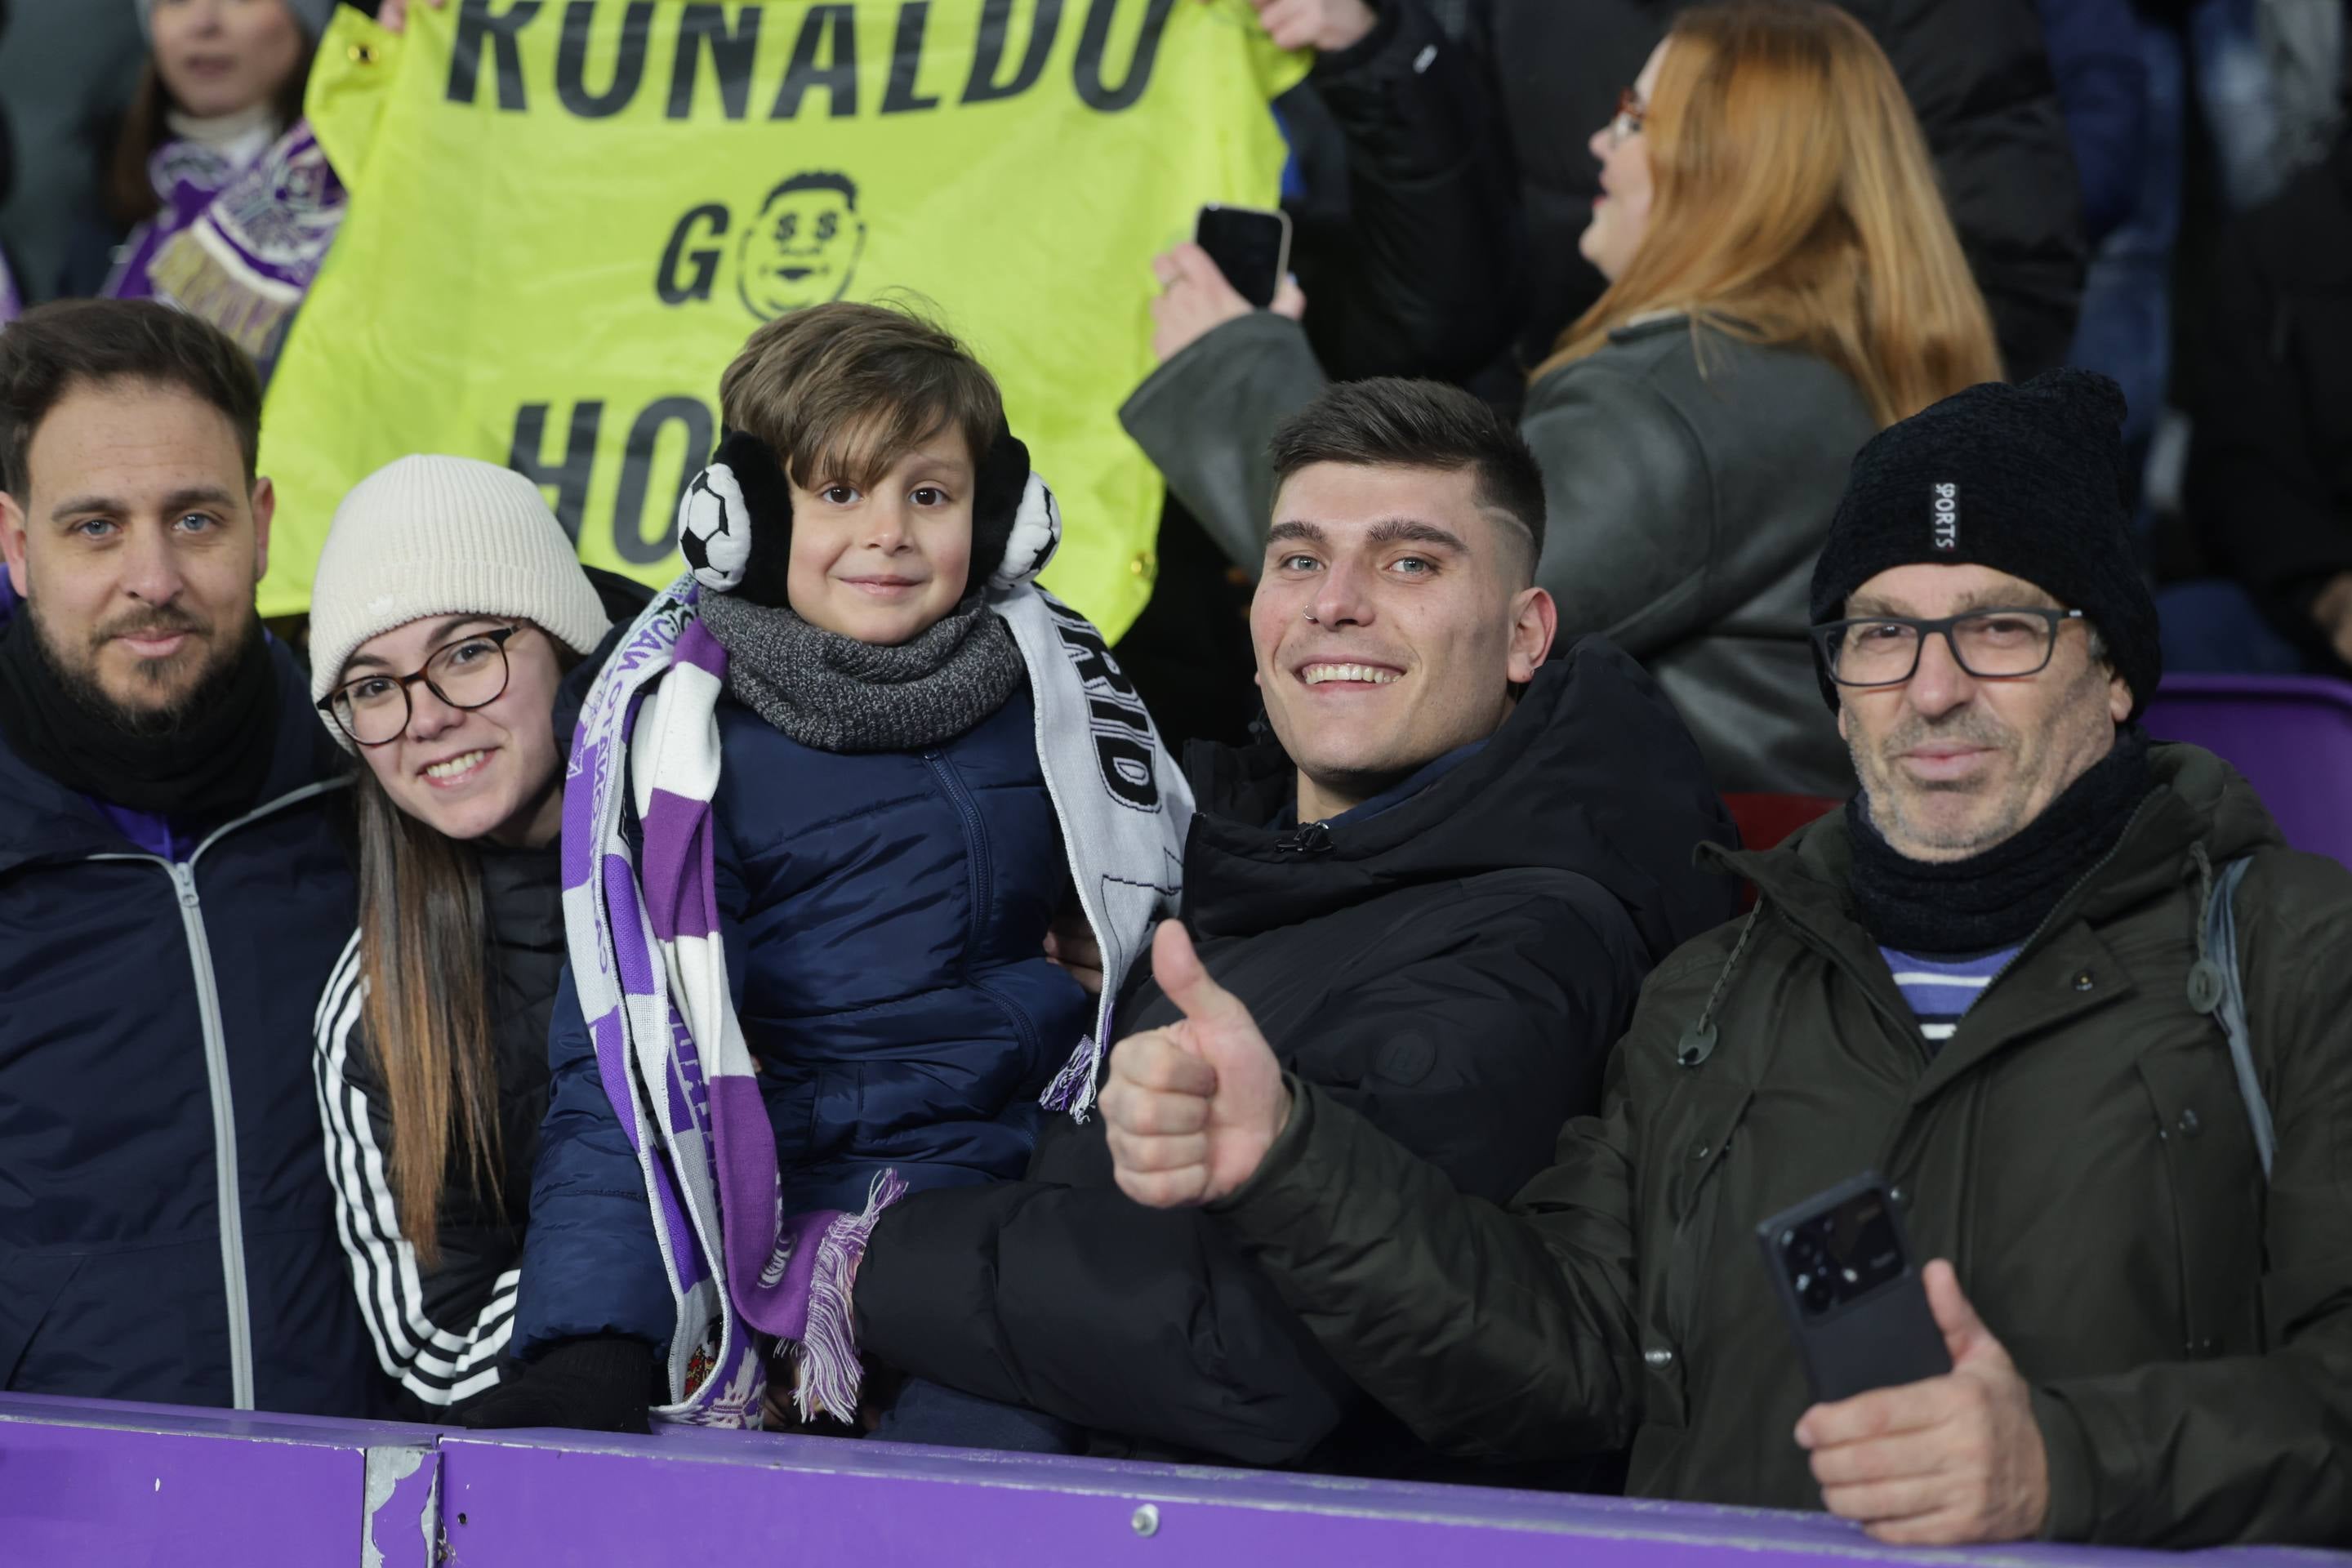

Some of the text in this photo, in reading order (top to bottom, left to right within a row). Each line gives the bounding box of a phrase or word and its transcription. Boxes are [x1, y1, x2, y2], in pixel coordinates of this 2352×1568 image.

[447, 0, 1177, 118] RONALDO
[507, 396, 715, 564] HO
[1935, 483, 1956, 550] SPORTS
